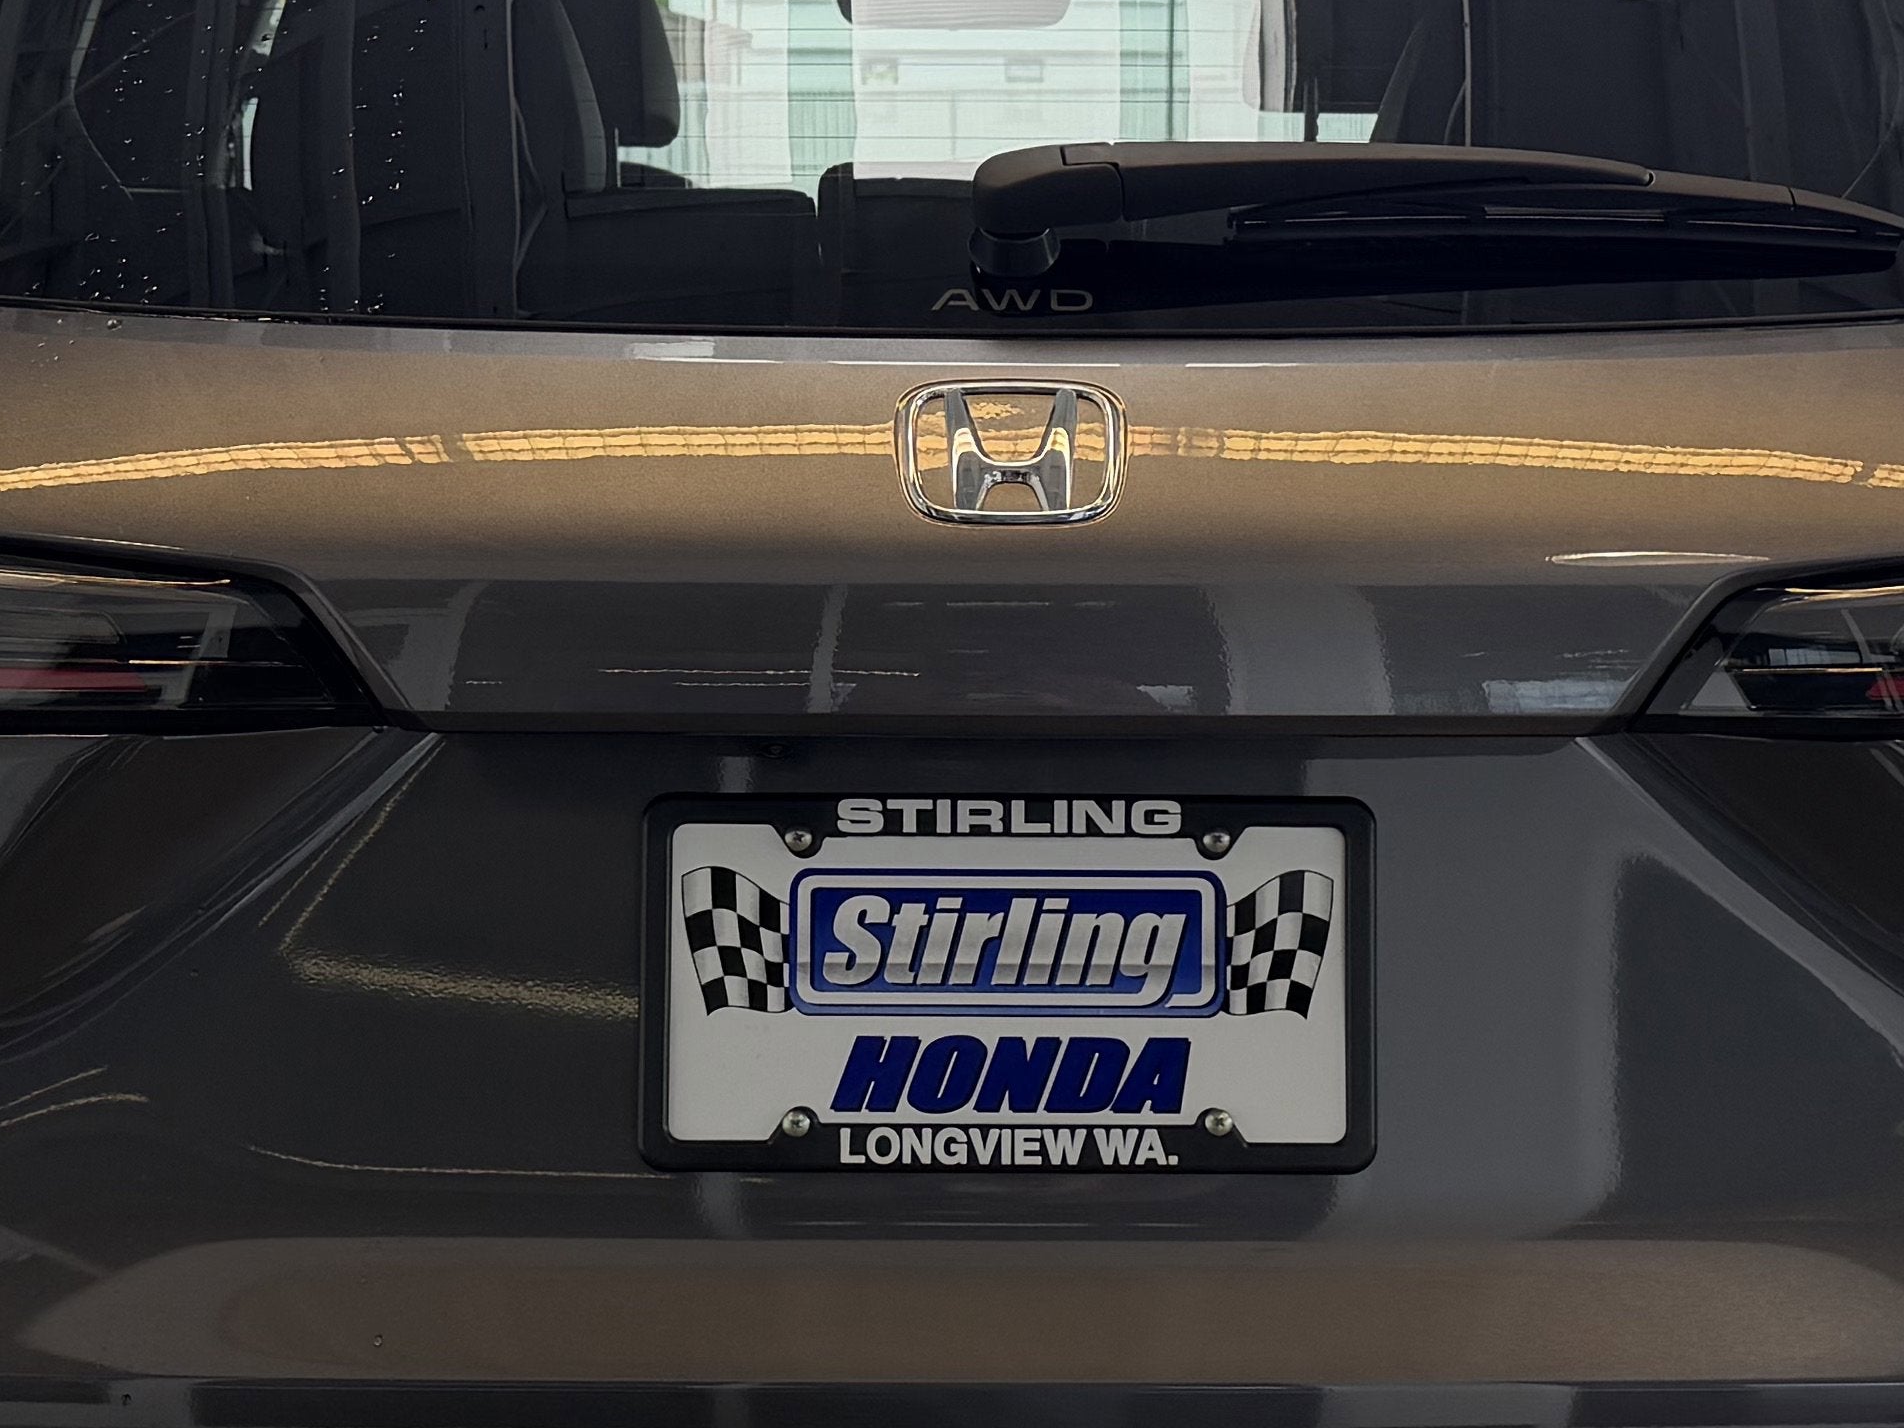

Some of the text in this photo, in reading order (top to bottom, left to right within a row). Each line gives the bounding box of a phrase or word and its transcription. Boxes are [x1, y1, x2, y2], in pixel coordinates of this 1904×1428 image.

[930, 288, 1094, 312] AWD
[836, 798, 1183, 835] STIRLING
[821, 894, 1188, 1007] Stirling
[829, 1034, 1192, 1115] HONDA
[839, 1126, 1179, 1166] LONGVIEW WA.
